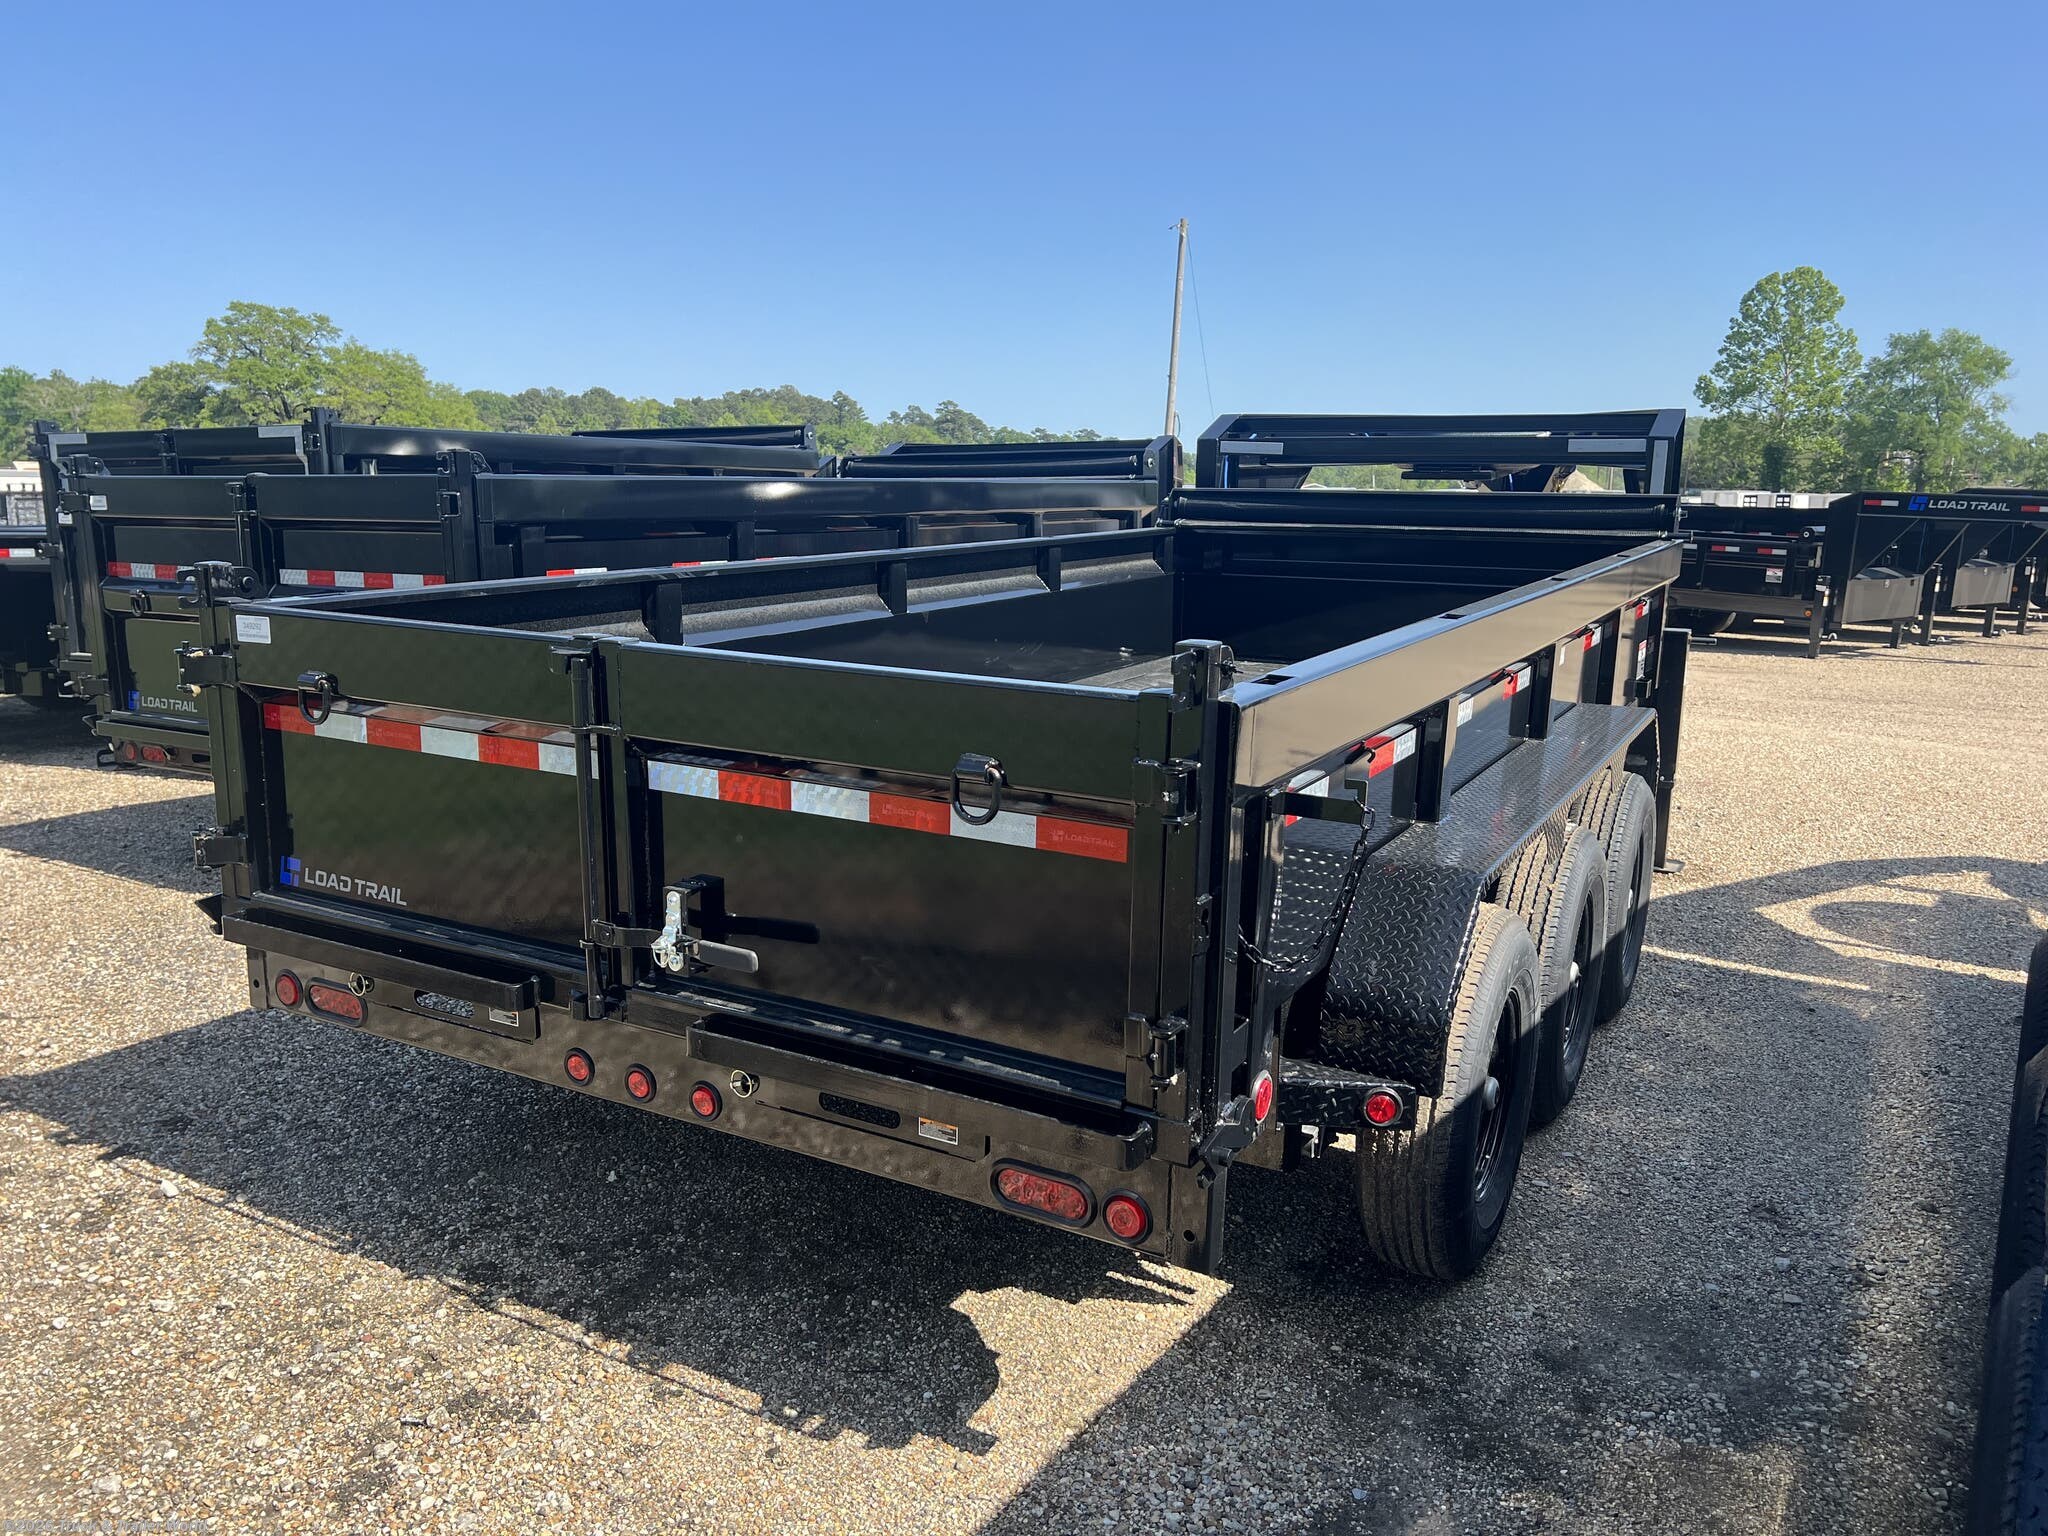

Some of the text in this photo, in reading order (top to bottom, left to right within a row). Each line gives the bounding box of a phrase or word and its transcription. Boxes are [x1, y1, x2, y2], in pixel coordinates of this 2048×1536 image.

[1928, 499, 2011, 512] LOAD TRAIL
[141, 695, 198, 713] LOAD TRAIL
[304, 867, 408, 906] LOAD TRAIL
